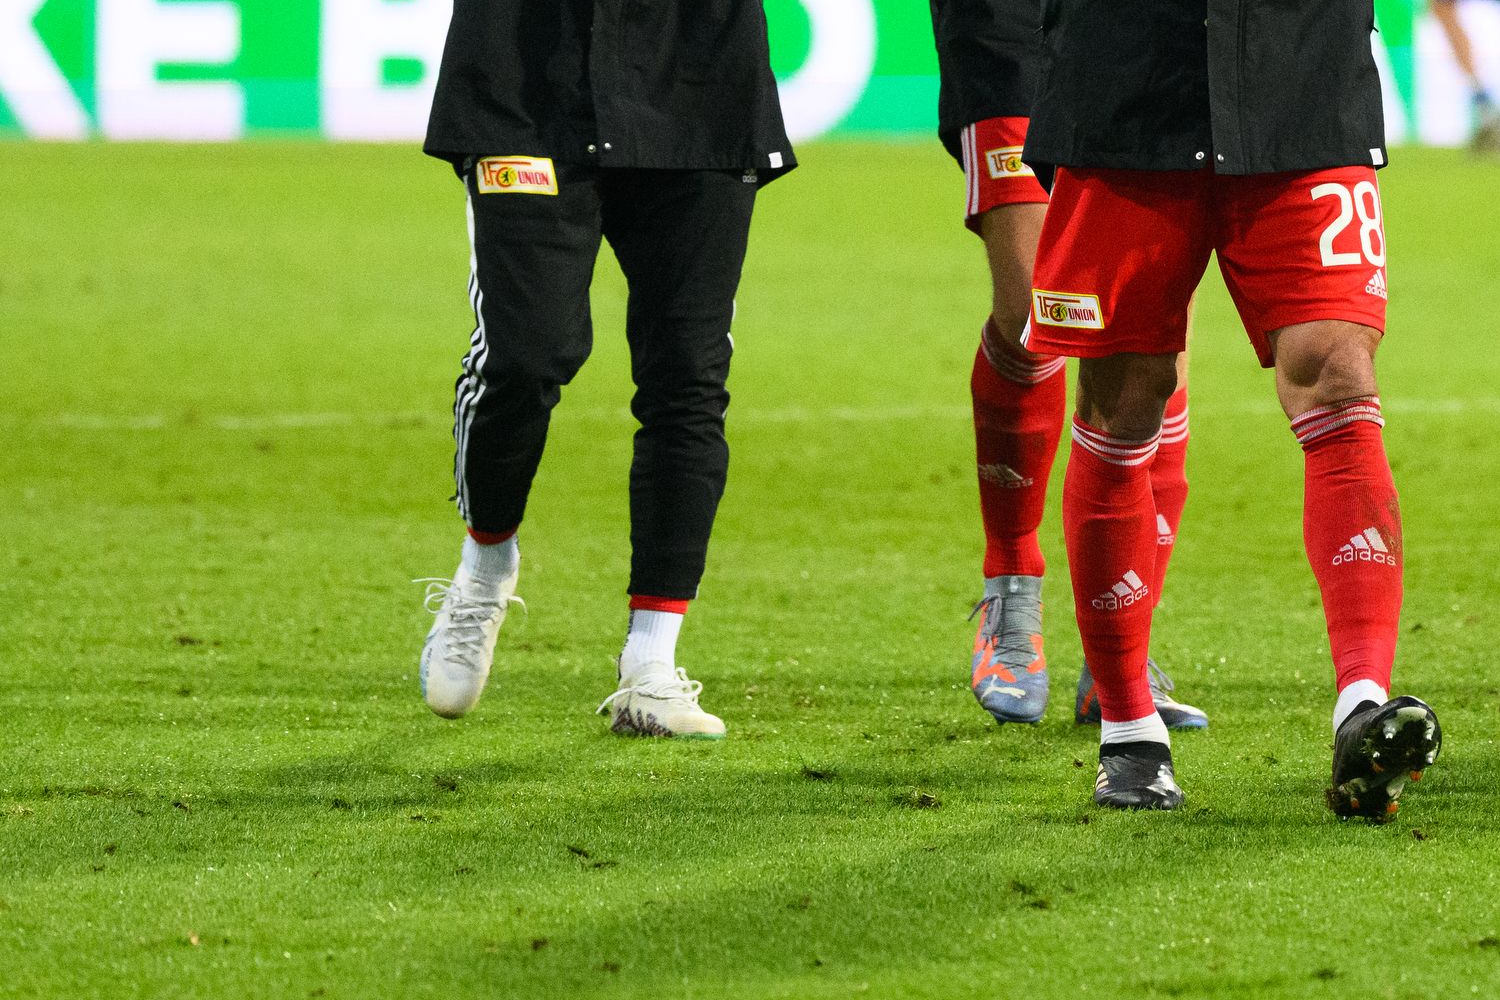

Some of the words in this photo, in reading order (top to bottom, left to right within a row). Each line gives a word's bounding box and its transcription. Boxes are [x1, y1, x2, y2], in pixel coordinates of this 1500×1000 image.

[517, 169, 549, 186] UNION
[1311, 181, 1385, 267] 28
[1067, 307, 1096, 321] UNION
[1332, 544, 1397, 566] adidas
[1092, 584, 1149, 611] adidas
